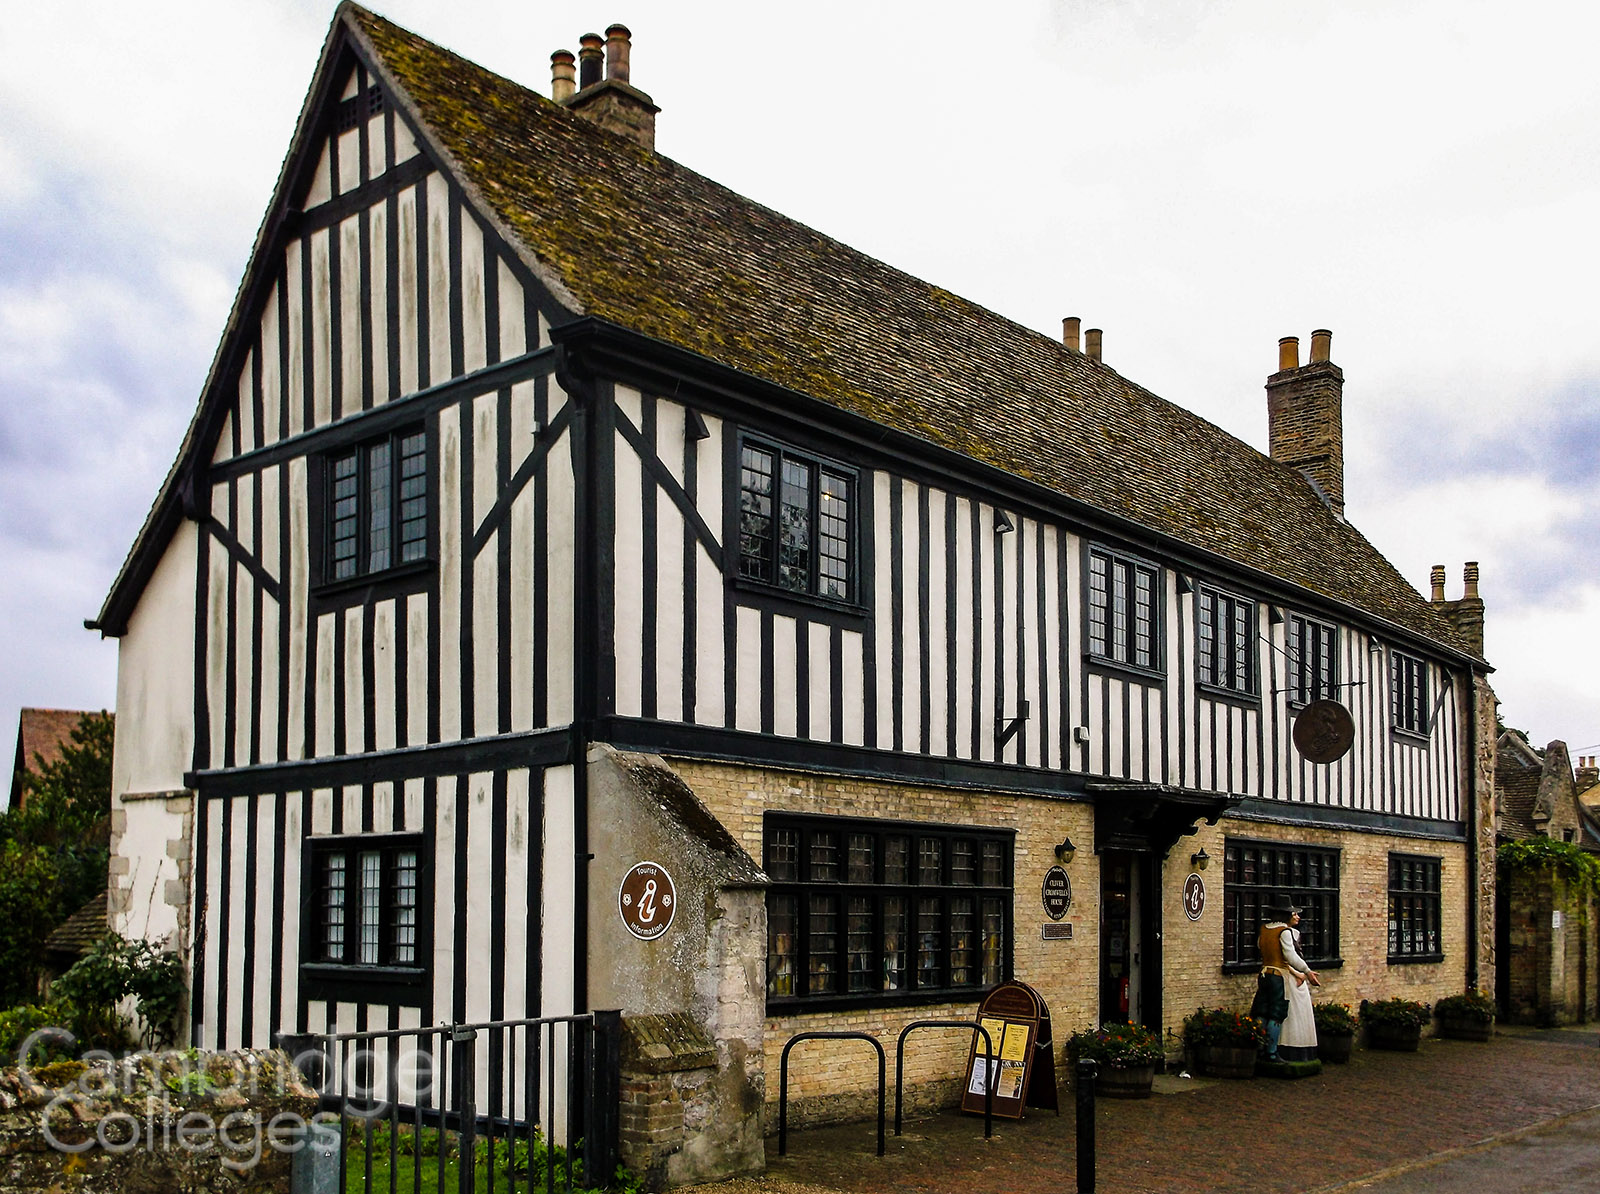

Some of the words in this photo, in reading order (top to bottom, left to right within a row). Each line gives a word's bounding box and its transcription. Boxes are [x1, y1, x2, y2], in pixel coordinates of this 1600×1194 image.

[636, 867, 658, 876] Tourist
[1049, 879, 1064, 887] OLIVER
[1050, 898, 1063, 906] HOUSE
[630, 921, 664, 935] Information
